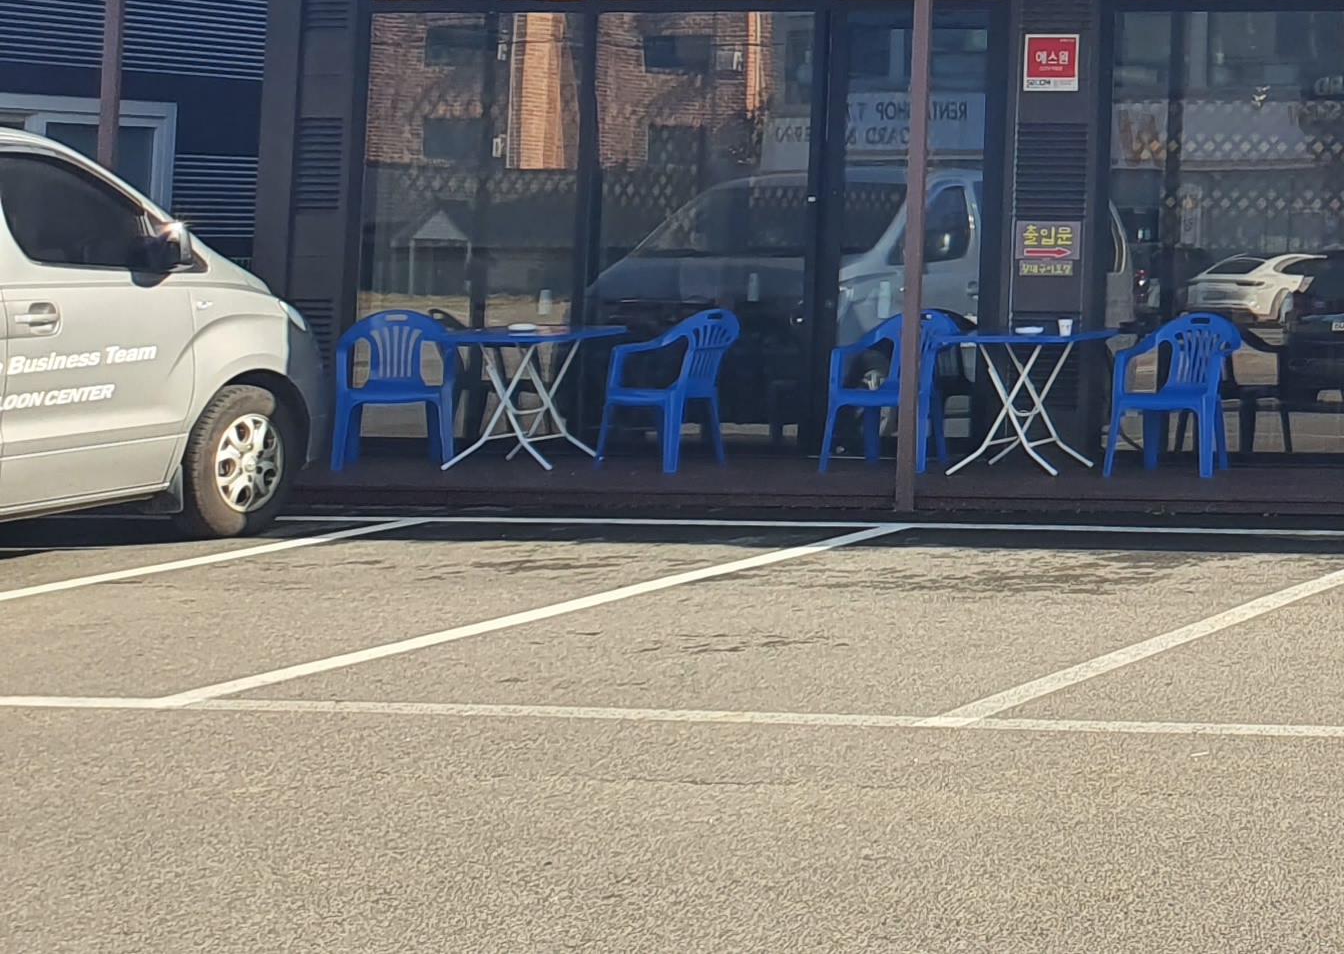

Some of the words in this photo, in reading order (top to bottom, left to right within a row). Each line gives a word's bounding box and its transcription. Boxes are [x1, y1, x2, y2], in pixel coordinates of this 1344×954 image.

[1023, 224, 1073, 246] 출입문
[7, 351, 101, 376] Business
[105, 345, 157, 365] Team
[0, 391, 44, 412] OON
[44, 383, 116, 406] CENTER
